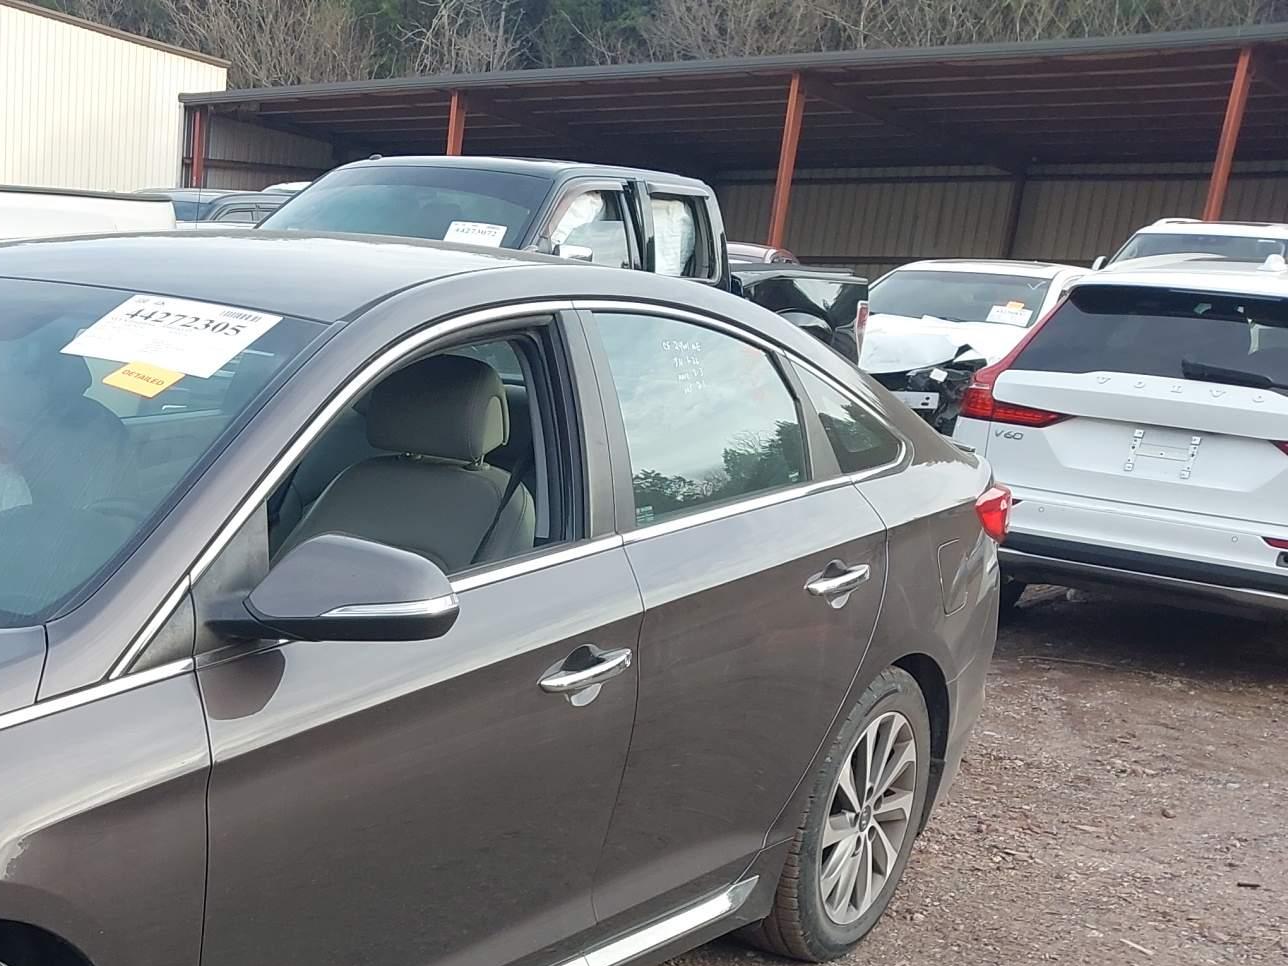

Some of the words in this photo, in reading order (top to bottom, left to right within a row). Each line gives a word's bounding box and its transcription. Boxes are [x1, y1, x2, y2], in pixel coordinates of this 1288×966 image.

[124, 308, 248, 337] 44272305
[121, 369, 166, 387] DETAILED
[1096, 375, 1265, 403] VOLVO
[994, 430, 1024, 441] V60
